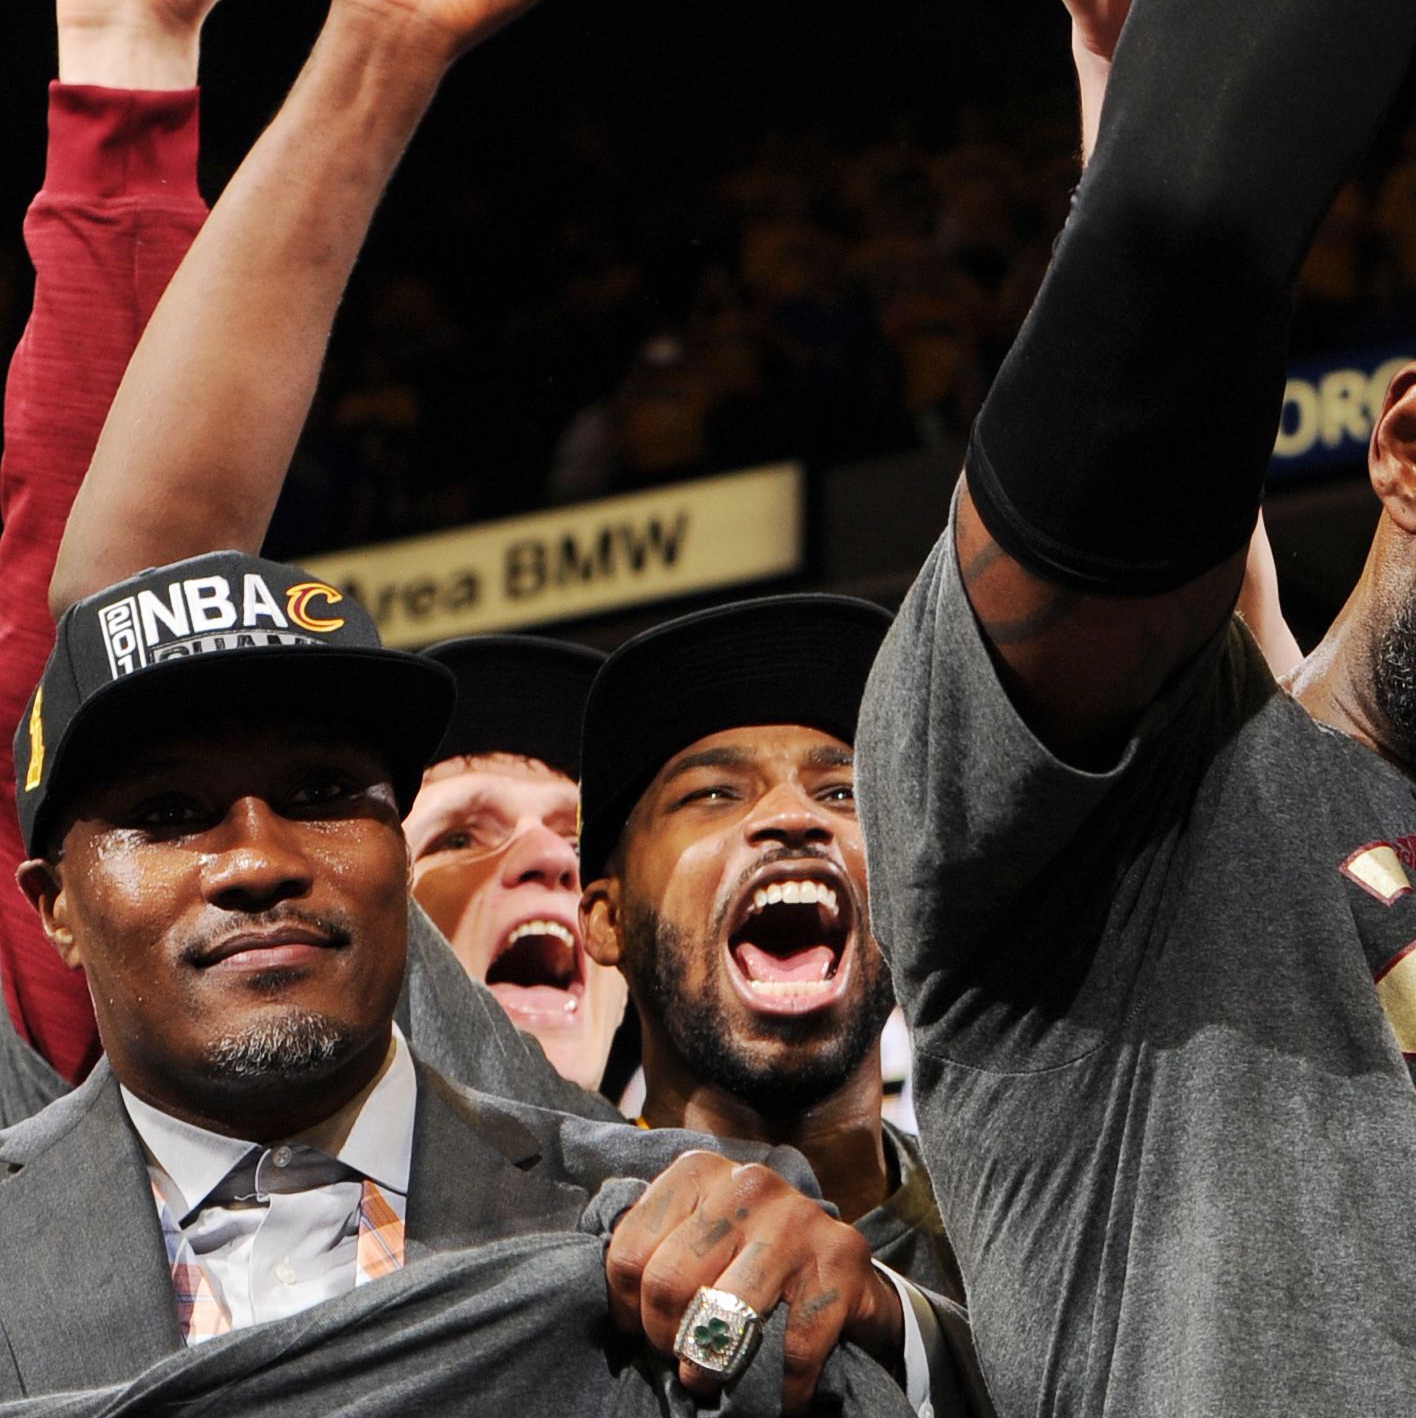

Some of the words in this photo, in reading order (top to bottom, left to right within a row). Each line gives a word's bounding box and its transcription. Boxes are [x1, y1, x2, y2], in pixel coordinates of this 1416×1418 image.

[503, 503, 692, 602] BMW
[106, 605, 137, 675] 201
[137, 573, 289, 647] NBA
